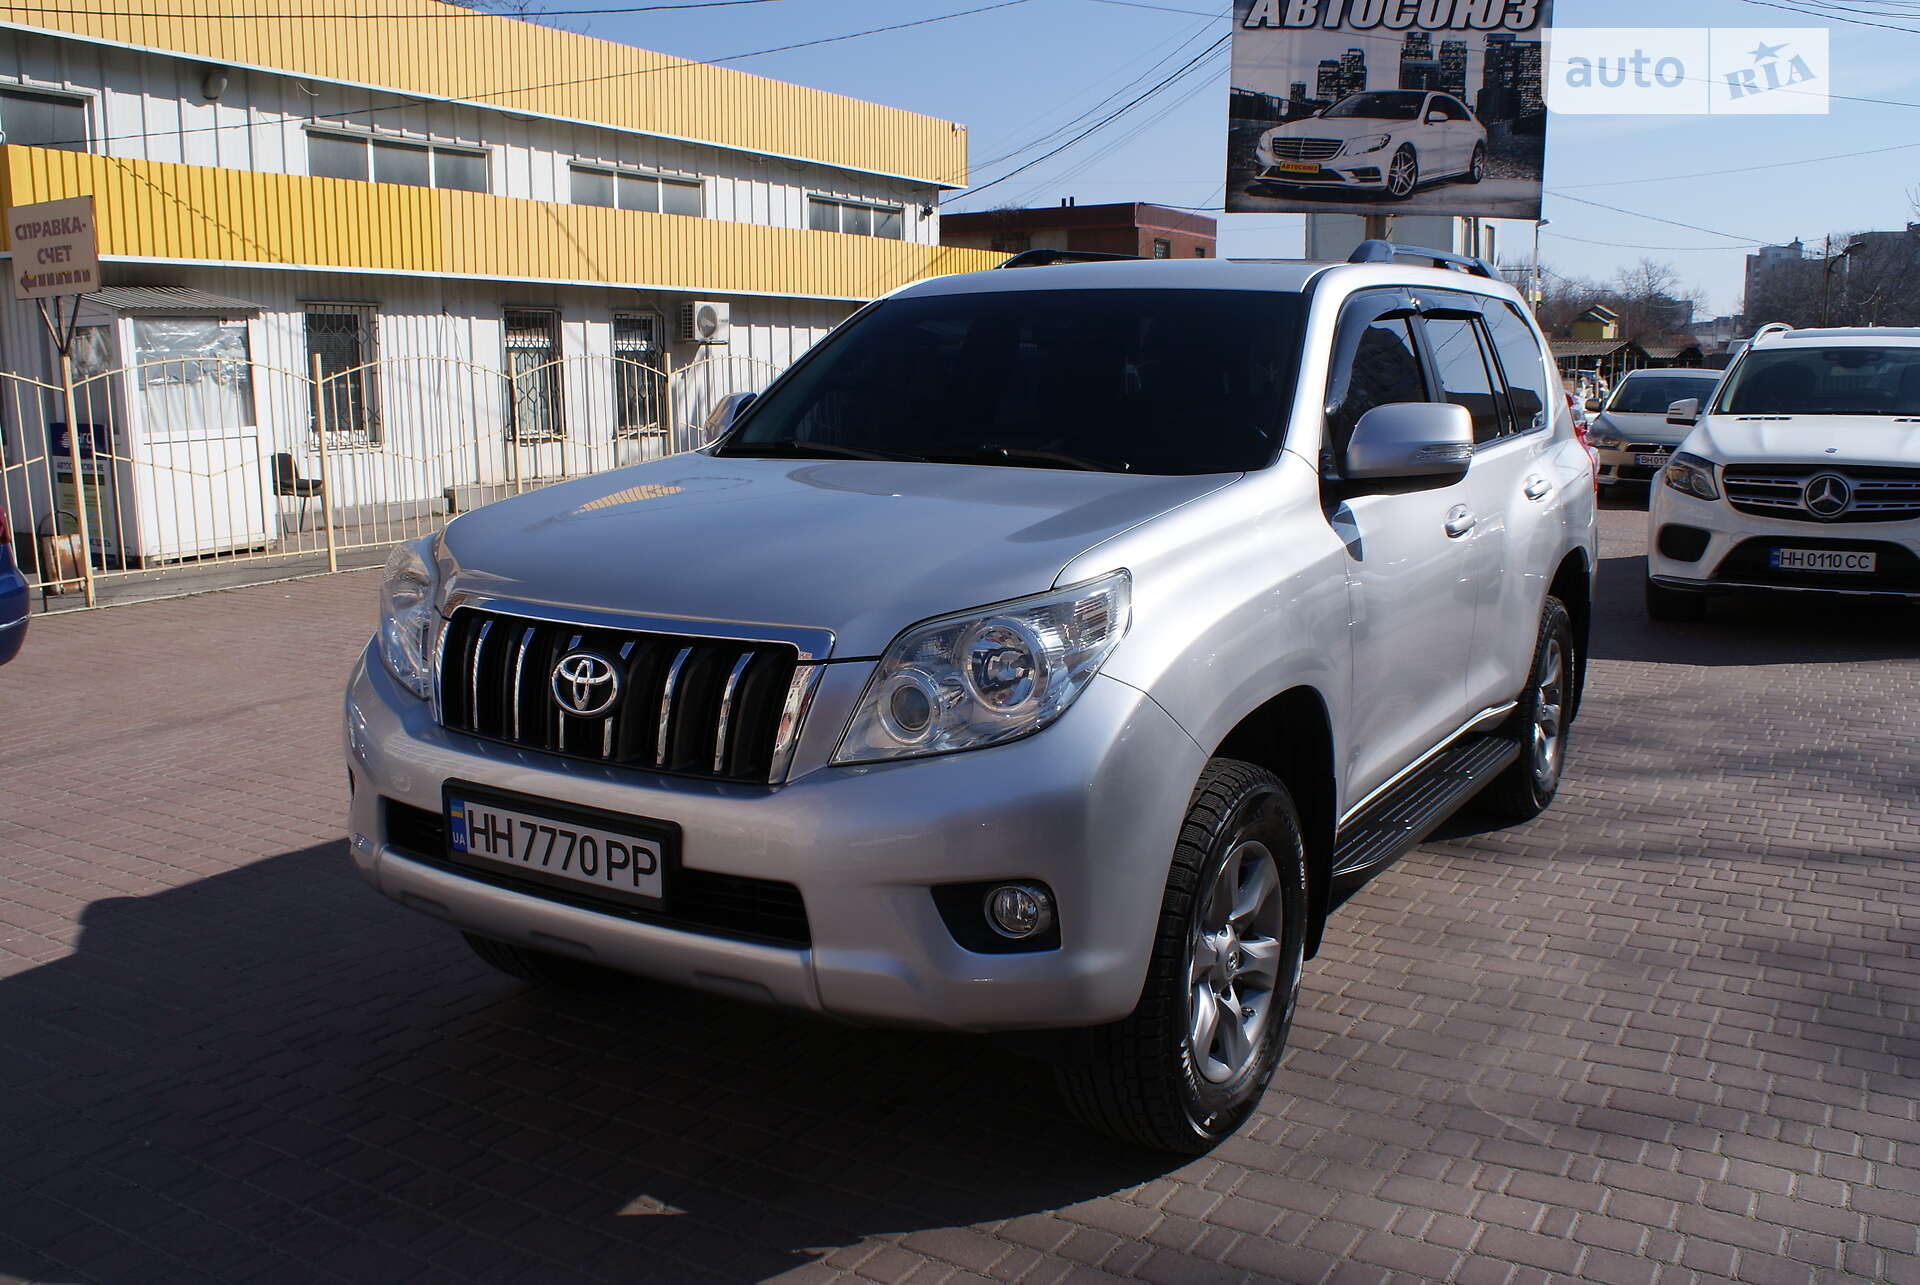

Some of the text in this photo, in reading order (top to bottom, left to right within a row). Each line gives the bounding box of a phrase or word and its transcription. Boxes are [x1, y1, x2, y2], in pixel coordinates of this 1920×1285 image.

[15, 216, 87, 240] СПРАВКА-
[37, 245, 72, 264] СЧЕТ
[1781, 552, 1870, 569] HH 0110 CC
[452, 832, 466, 845] UA
[468, 810, 657, 887] HH 7770 PP
